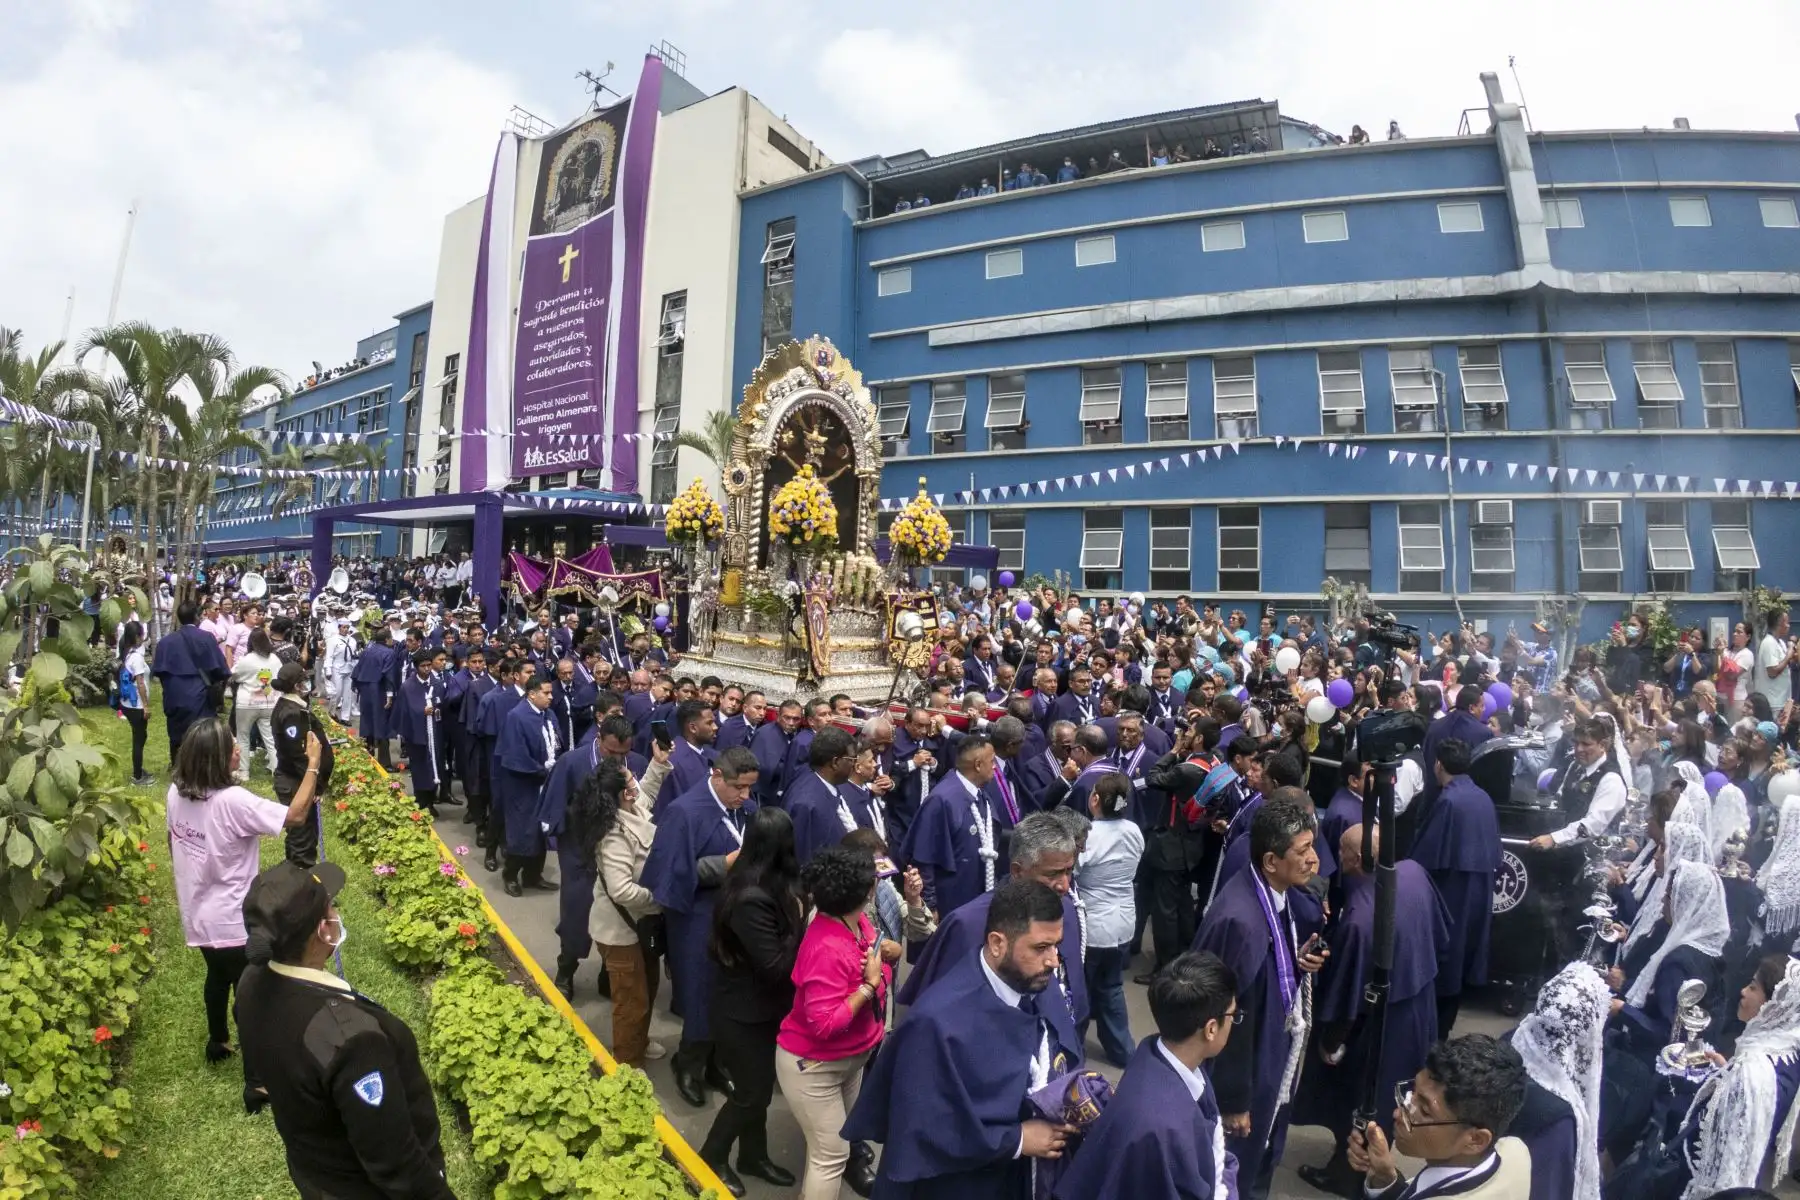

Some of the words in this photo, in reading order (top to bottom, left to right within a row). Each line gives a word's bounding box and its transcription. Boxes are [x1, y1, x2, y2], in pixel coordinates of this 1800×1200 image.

[535, 289, 580, 312] Derrama
[523, 311, 558, 328] sagrada
[560, 297, 605, 316] bendición
[546, 316, 585, 335] nuestros
[533, 331, 588, 352] asegurados,
[529, 346, 581, 367] autoridades
[526, 359, 594, 381] colaboradores.
[523, 400, 554, 413] Hospital
[555, 391, 589, 407] Nacional
[516, 412, 554, 426] Guillermo
[556, 405, 598, 418] Almenara
[538, 422, 572, 435] Irigoyen
[546, 445, 589, 465] EsSalud
